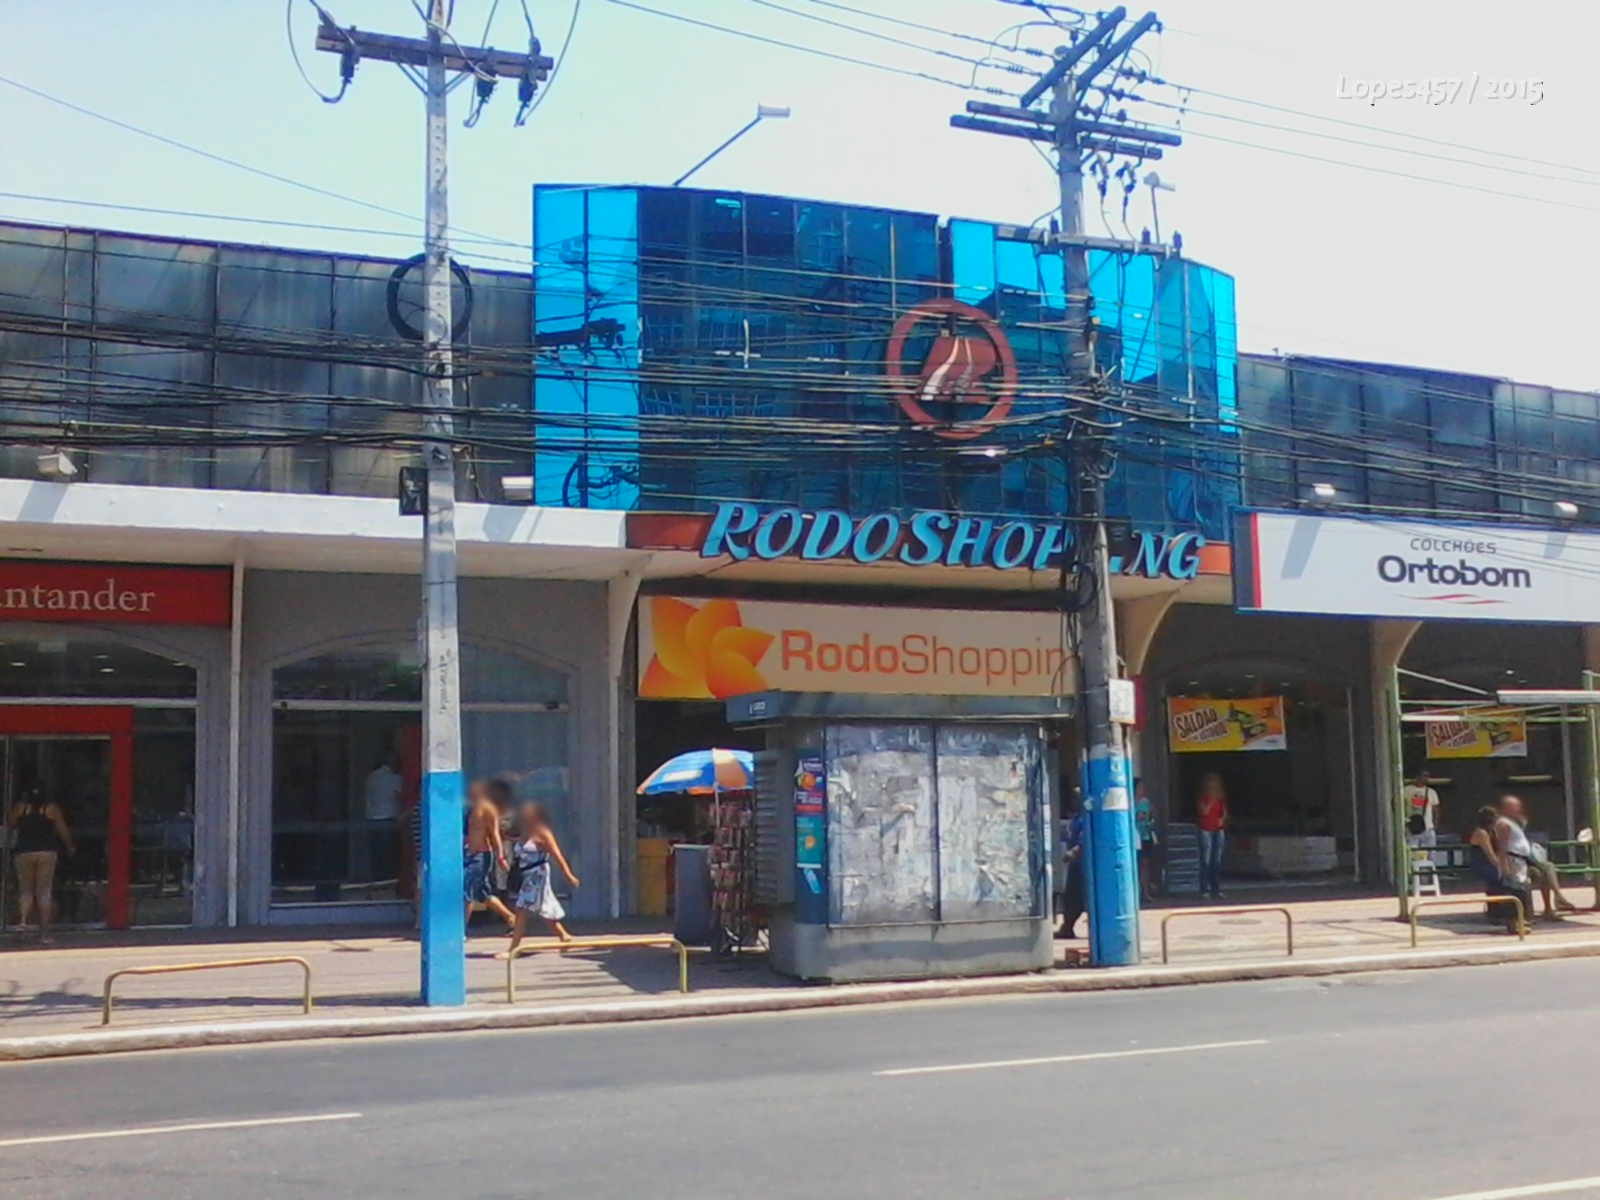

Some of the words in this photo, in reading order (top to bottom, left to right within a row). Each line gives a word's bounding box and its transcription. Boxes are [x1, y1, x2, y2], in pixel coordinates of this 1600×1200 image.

[699, 500, 1206, 580] RODOSHOPNG
[0, 577, 156, 612] ntander
[1376, 554, 1533, 589] Ortobom
[781, 629, 1068, 687] RodoShoppin
